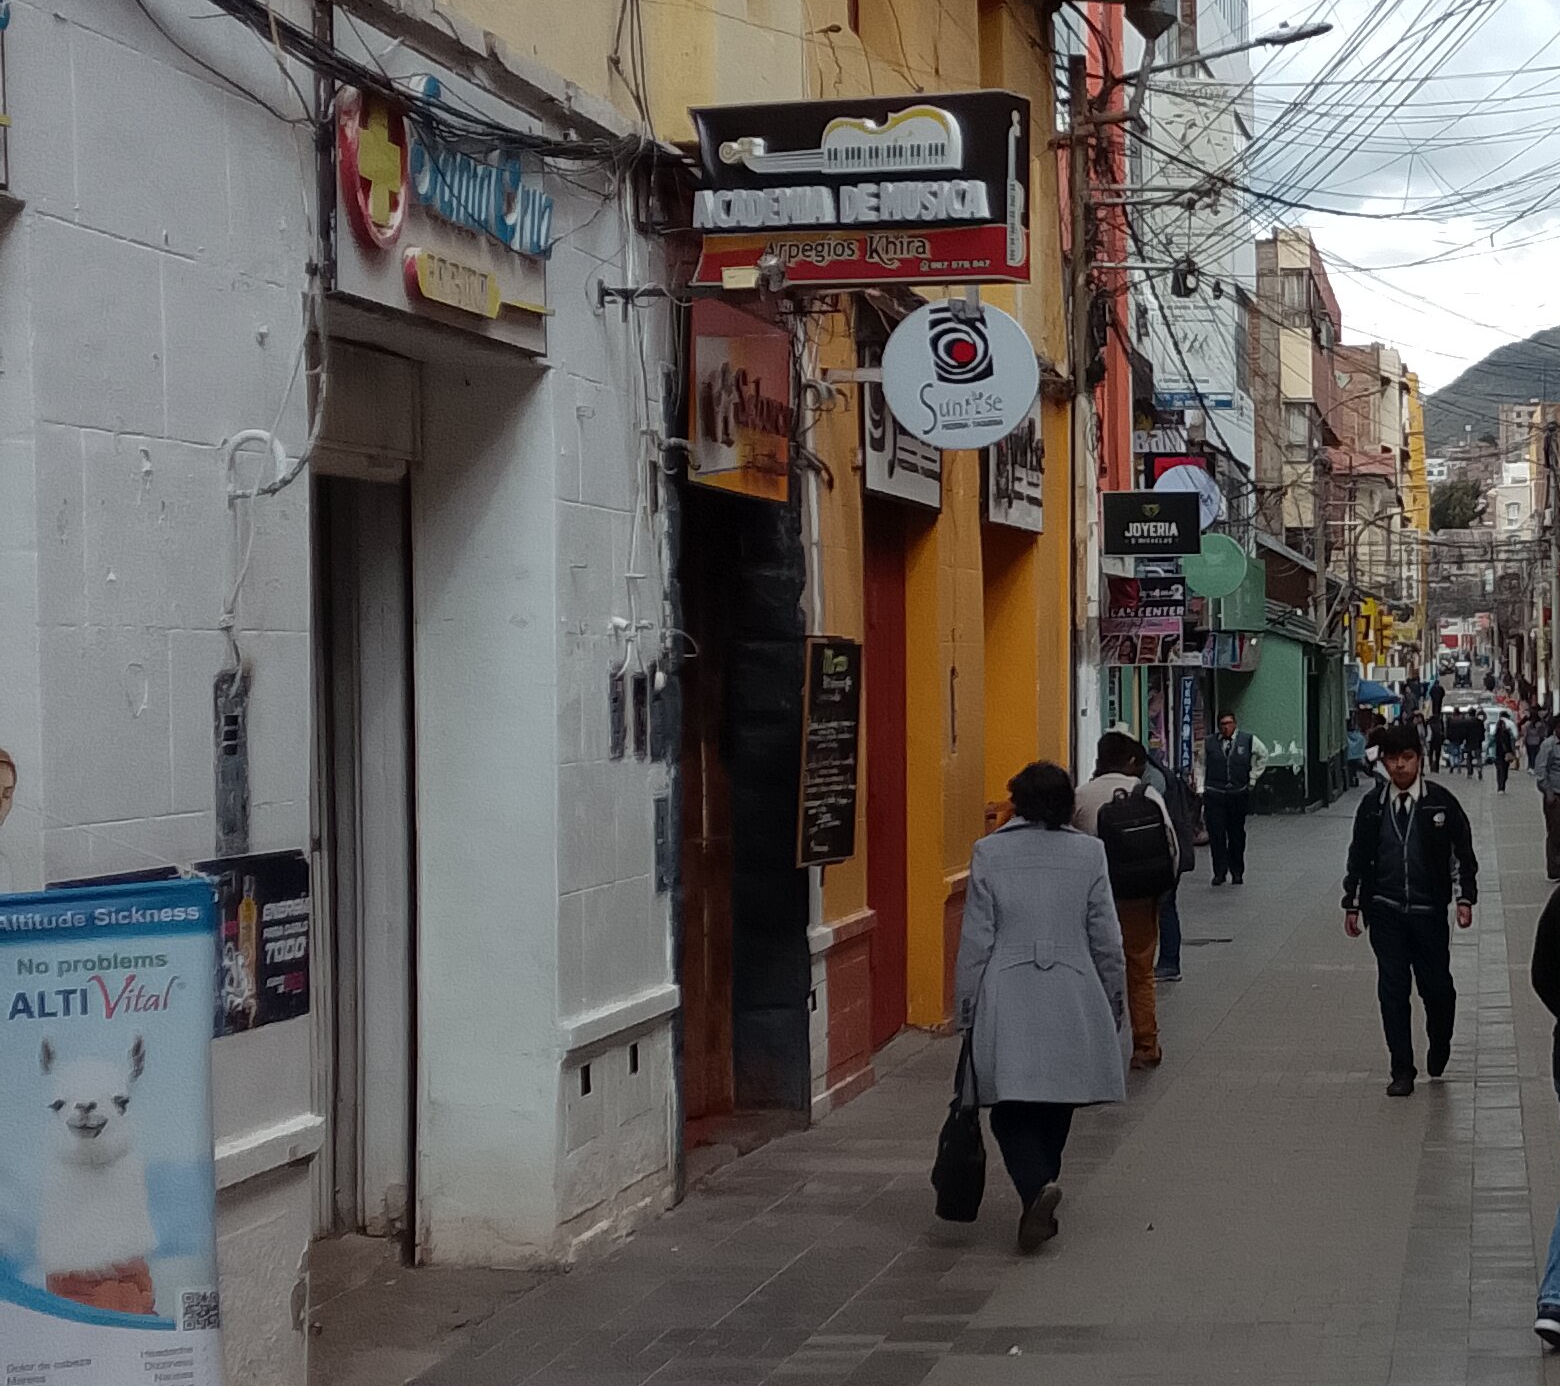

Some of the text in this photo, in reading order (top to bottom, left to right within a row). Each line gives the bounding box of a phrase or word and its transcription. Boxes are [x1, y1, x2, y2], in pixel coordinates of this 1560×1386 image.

[692, 185, 837, 229] ACADEMIA
[839, 182, 880, 224] DE
[763, 232, 929, 269] Arpegios Khira
[1124, 521, 1179, 537] JOYERIA
[1137, 605, 1185, 617] CENTER
[0, 906, 200, 933] Altitude Sickness
[17, 953, 168, 977] No problems
